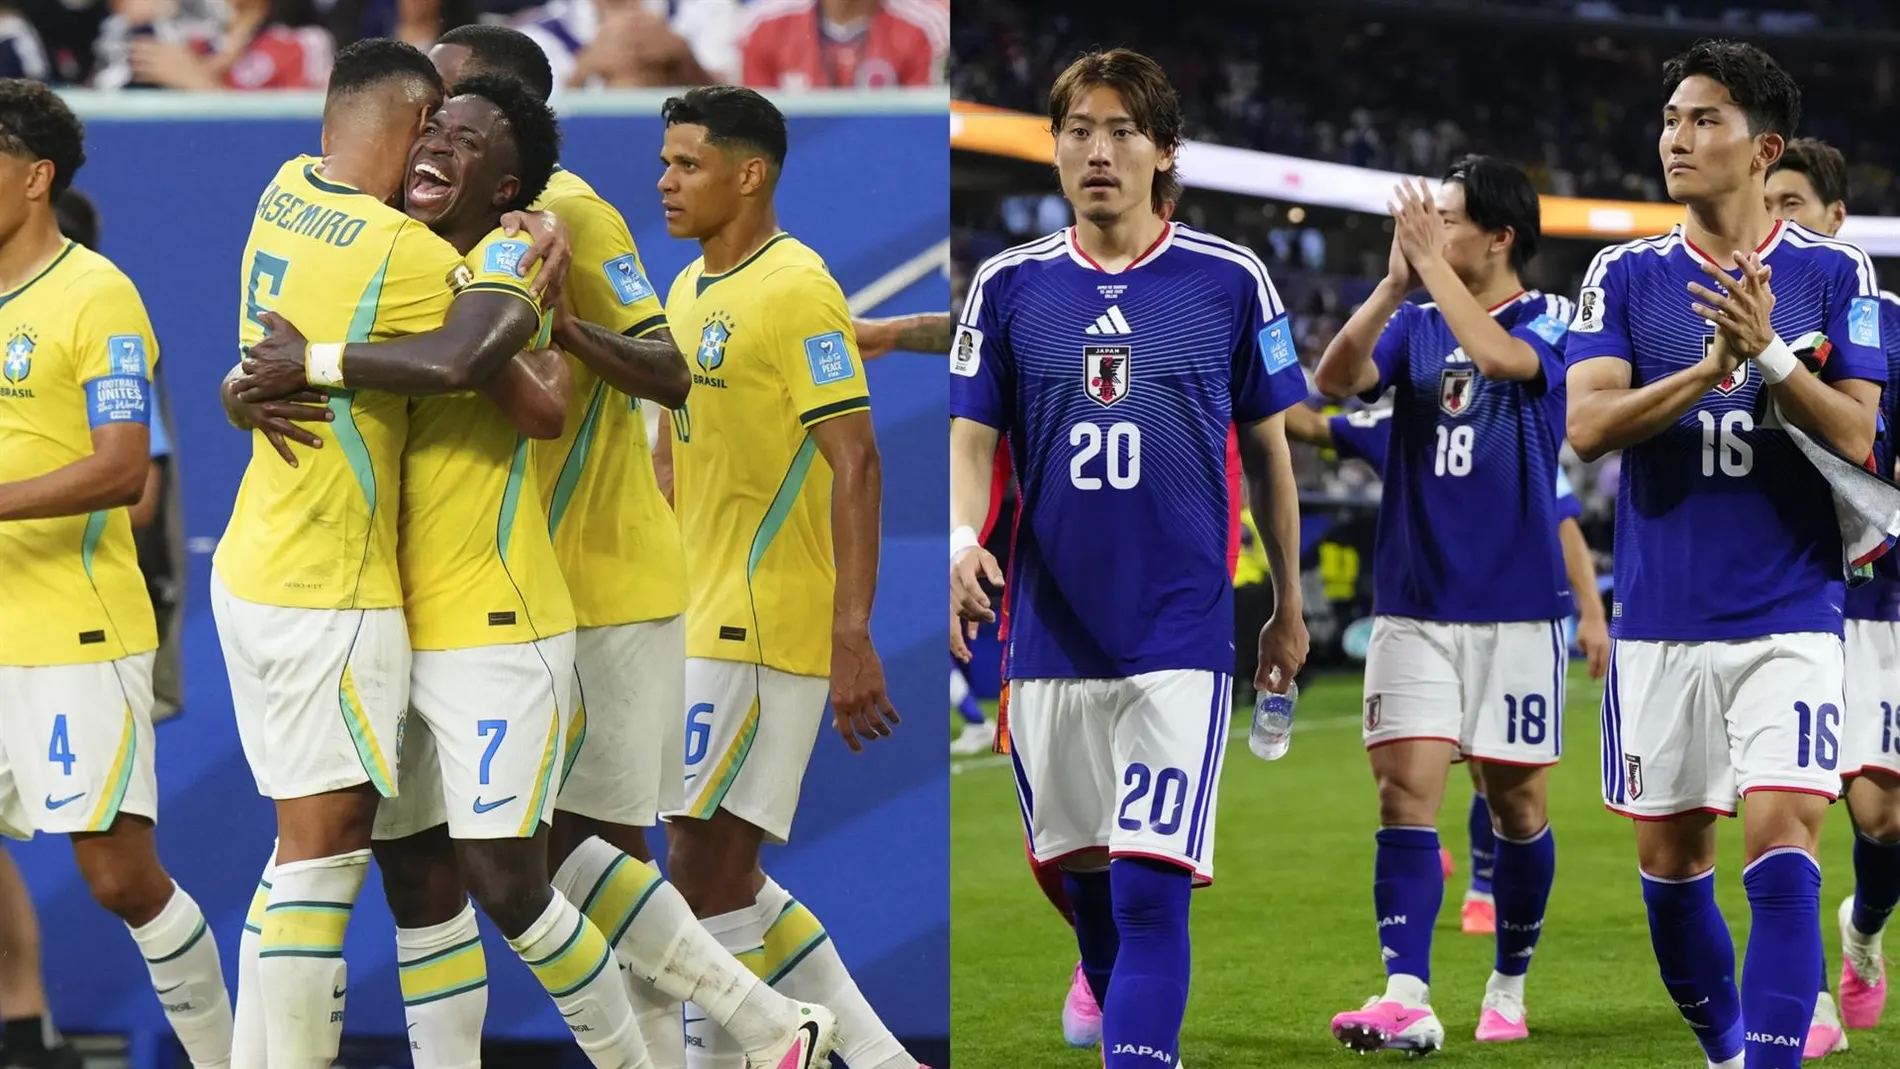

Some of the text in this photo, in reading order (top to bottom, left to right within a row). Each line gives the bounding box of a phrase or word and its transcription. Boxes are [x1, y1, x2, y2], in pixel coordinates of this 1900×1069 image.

[257, 182, 368, 248] ASEMIRO
[0, 386, 36, 398] BRASIL
[97, 378, 140, 390] FOOTBALL
[694, 373, 728, 389] BRASIL
[822, 360, 843, 374] PEACE
[97, 387, 143, 402] UNITES
[1070, 421, 1141, 491] 20
[1435, 425, 1475, 477] 18
[1698, 409, 1754, 477] 16
[49, 714, 76, 776] 4
[1504, 693, 1546, 745] 18
[1794, 701, 1840, 771] 16
[478, 719, 508, 785] 7
[1118, 762, 1188, 836] 20
[1111, 1043, 1172, 1065] JAPAN
[1745, 1032, 1801, 1047] JAPAN
